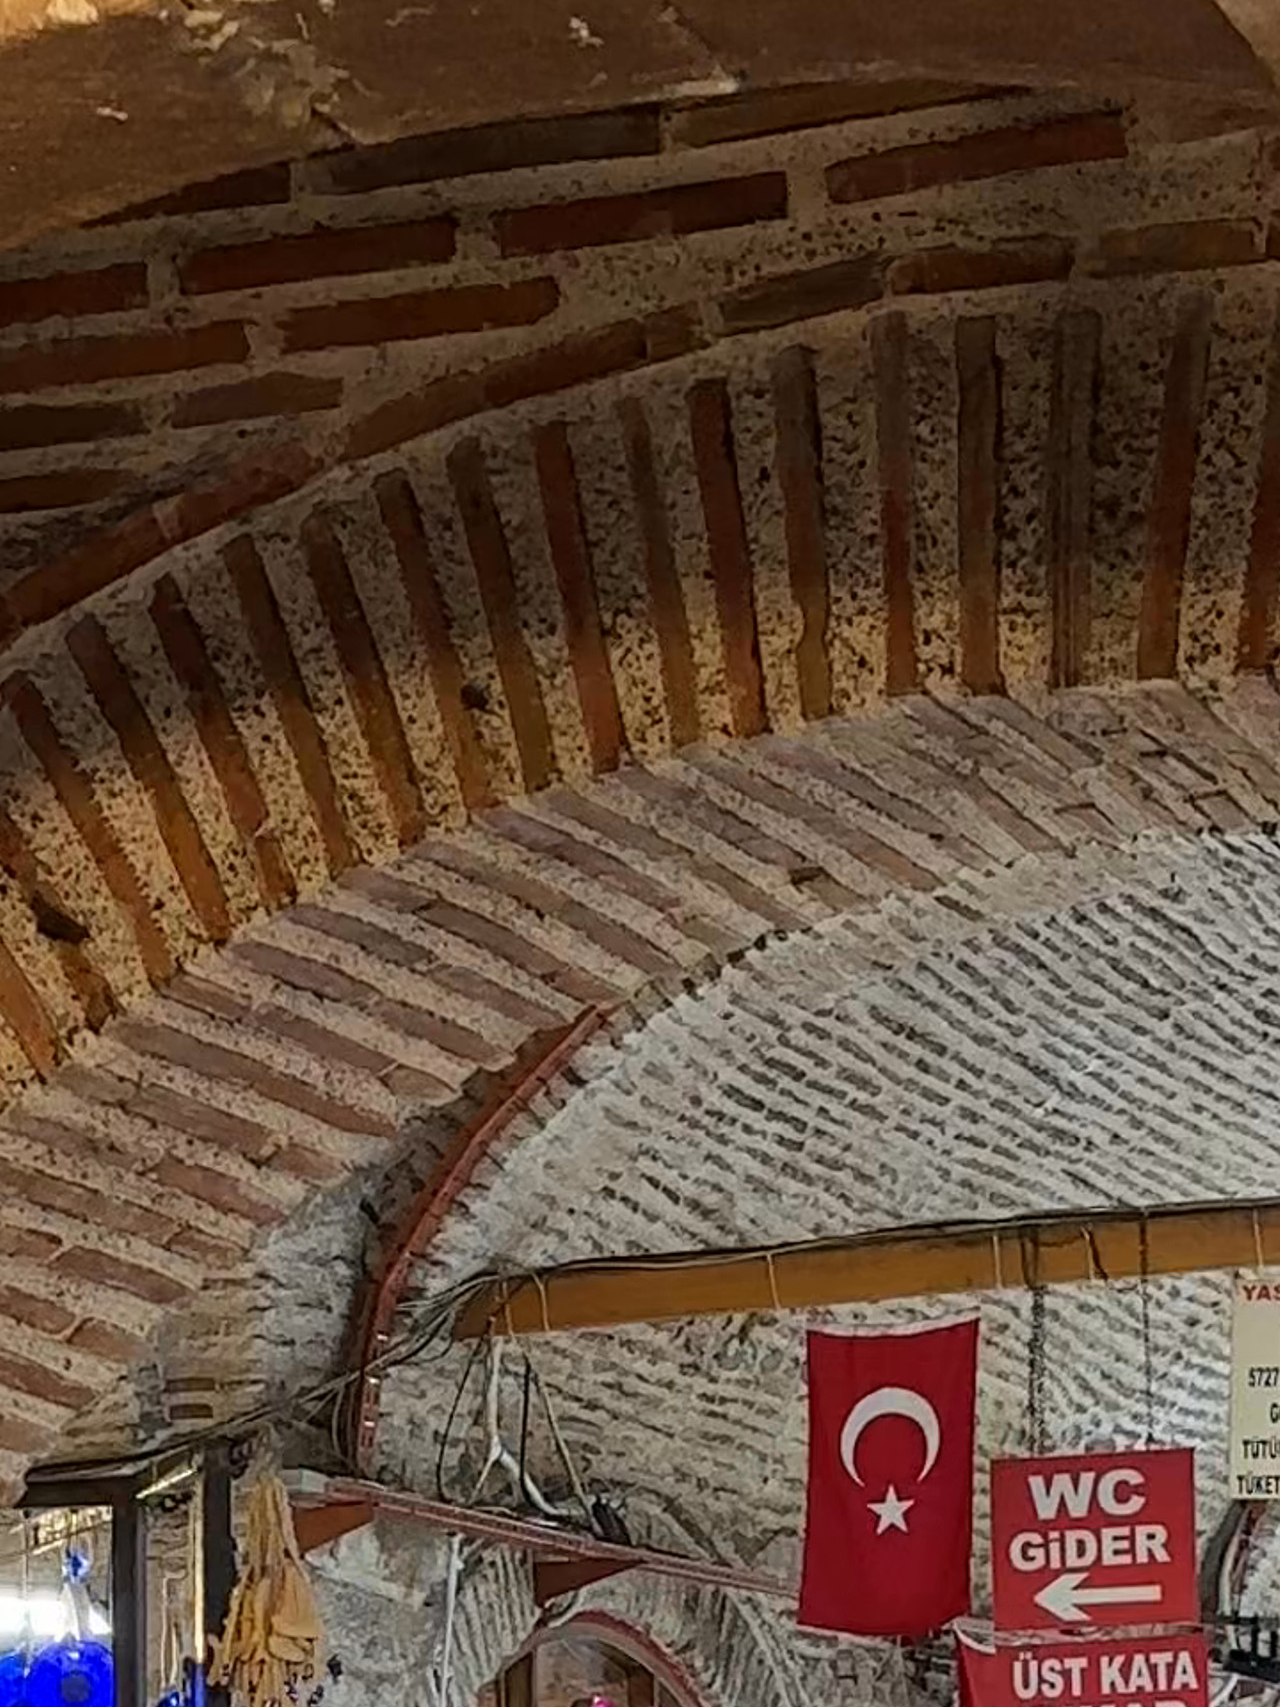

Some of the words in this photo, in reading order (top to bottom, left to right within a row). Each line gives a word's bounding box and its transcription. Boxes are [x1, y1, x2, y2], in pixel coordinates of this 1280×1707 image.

[1248, 1367, 1279, 1387] 5727
[1027, 1468, 1146, 1521] WC
[1012, 1652, 1088, 1700] ÜST
[1100, 1651, 1198, 1695] KATA
